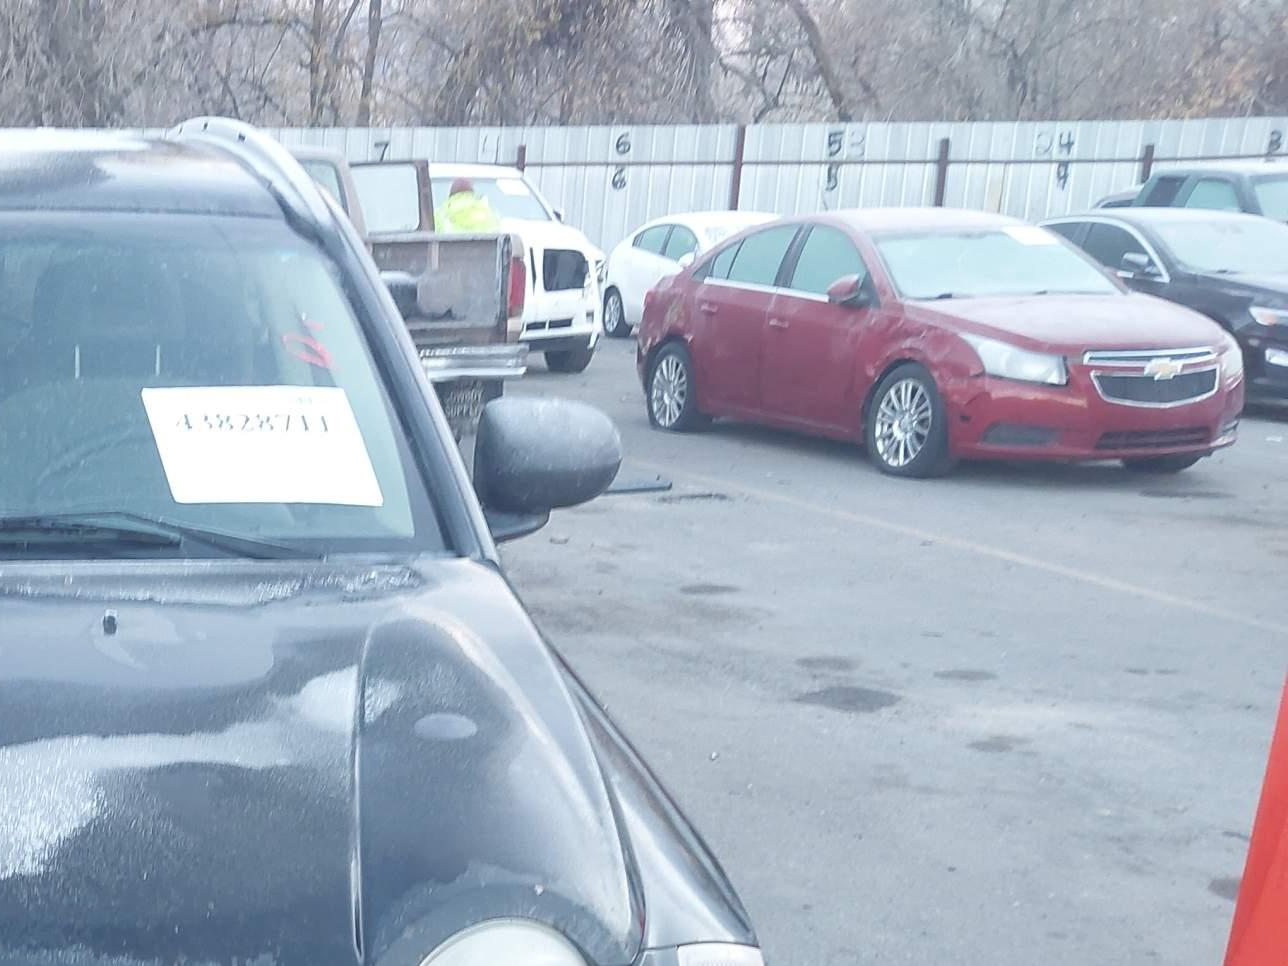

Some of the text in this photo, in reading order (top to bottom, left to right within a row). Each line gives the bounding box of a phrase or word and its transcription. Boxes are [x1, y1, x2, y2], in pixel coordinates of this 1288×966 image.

[374, 139, 390, 162] 7
[615, 131, 632, 156] 6
[827, 130, 844, 158] 5
[1059, 130, 1075, 156] 4
